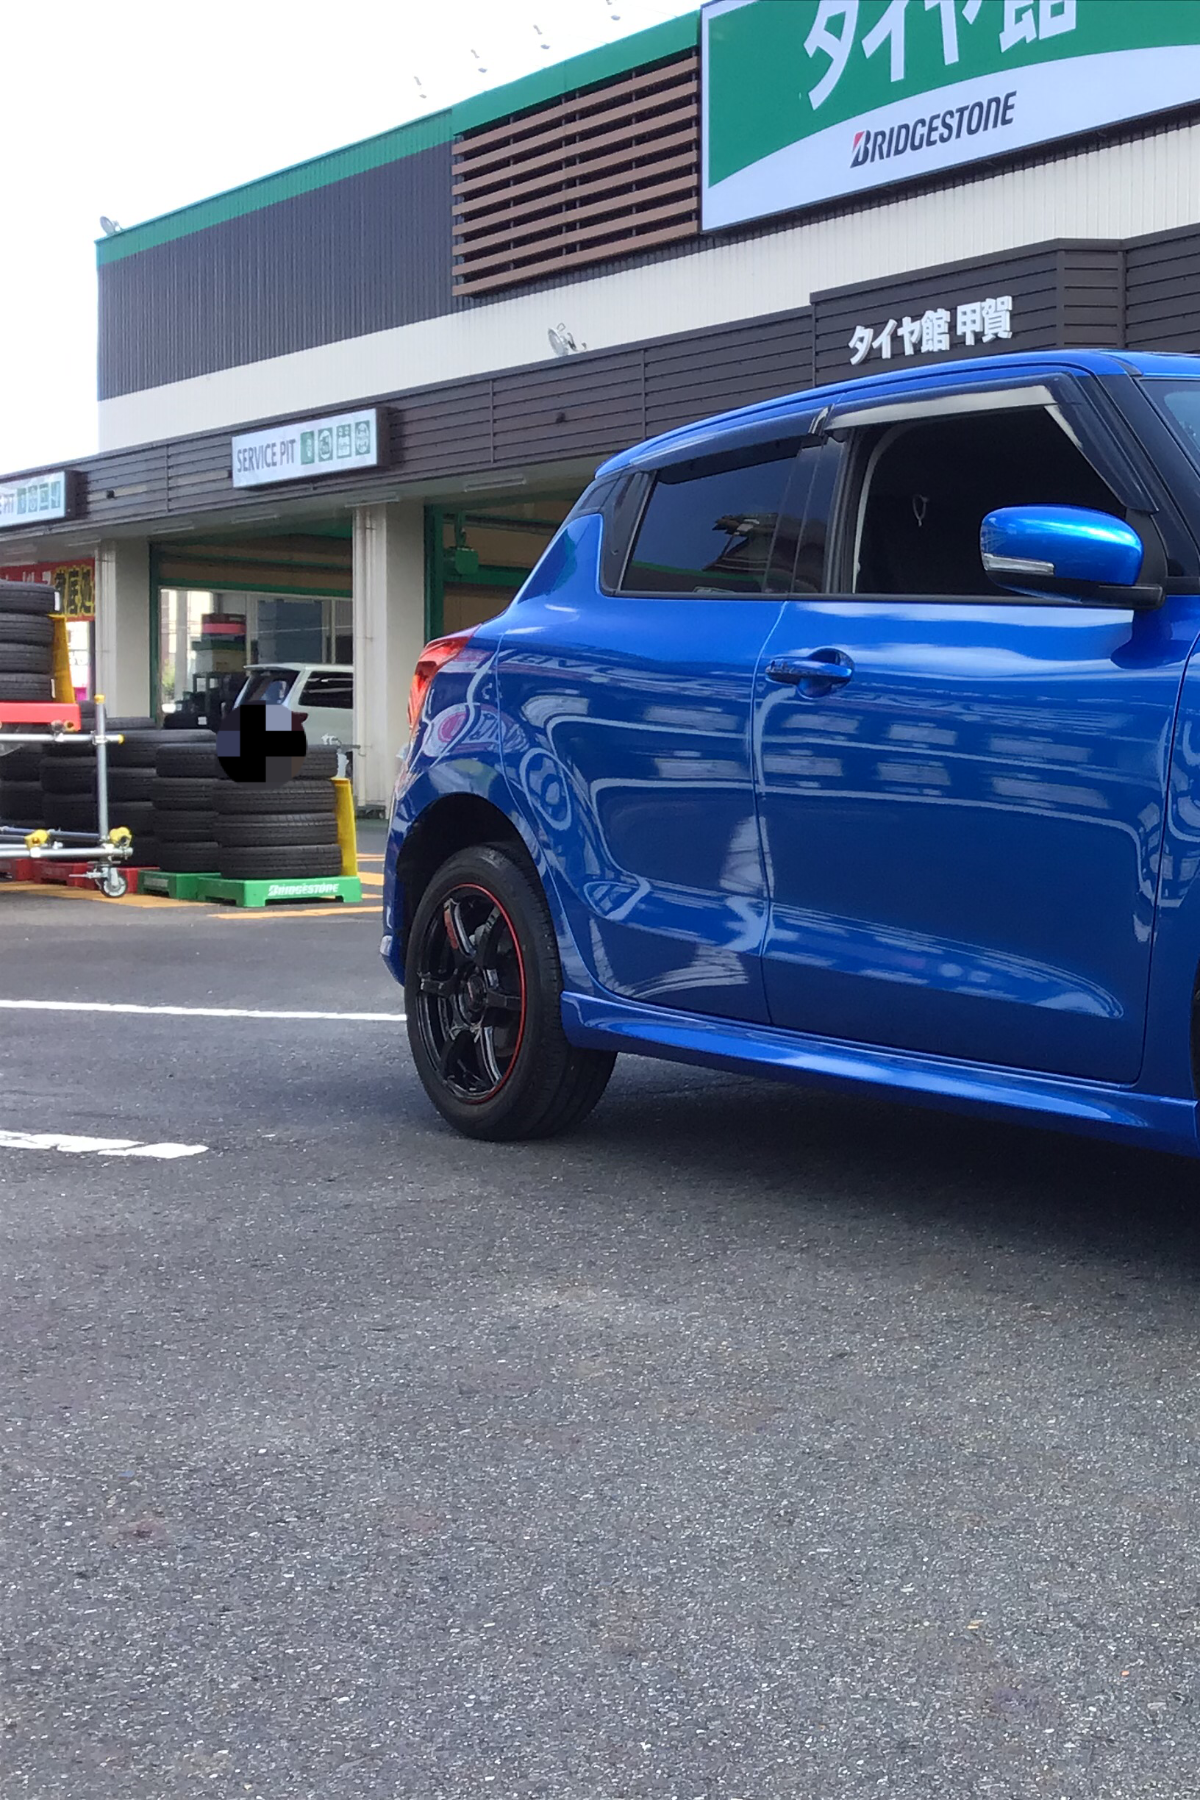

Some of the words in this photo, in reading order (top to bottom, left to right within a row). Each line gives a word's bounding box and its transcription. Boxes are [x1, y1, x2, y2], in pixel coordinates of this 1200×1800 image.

[849, 90, 1017, 169] BRIDGESTONE
[848, 307, 951, 366] タイヤ館
[956, 295, 1013, 346] 甲賀
[237, 442, 278, 473] SERVICE
[280, 438, 296, 466] PIT
[268, 882, 340, 897] BRIDGESTONE
